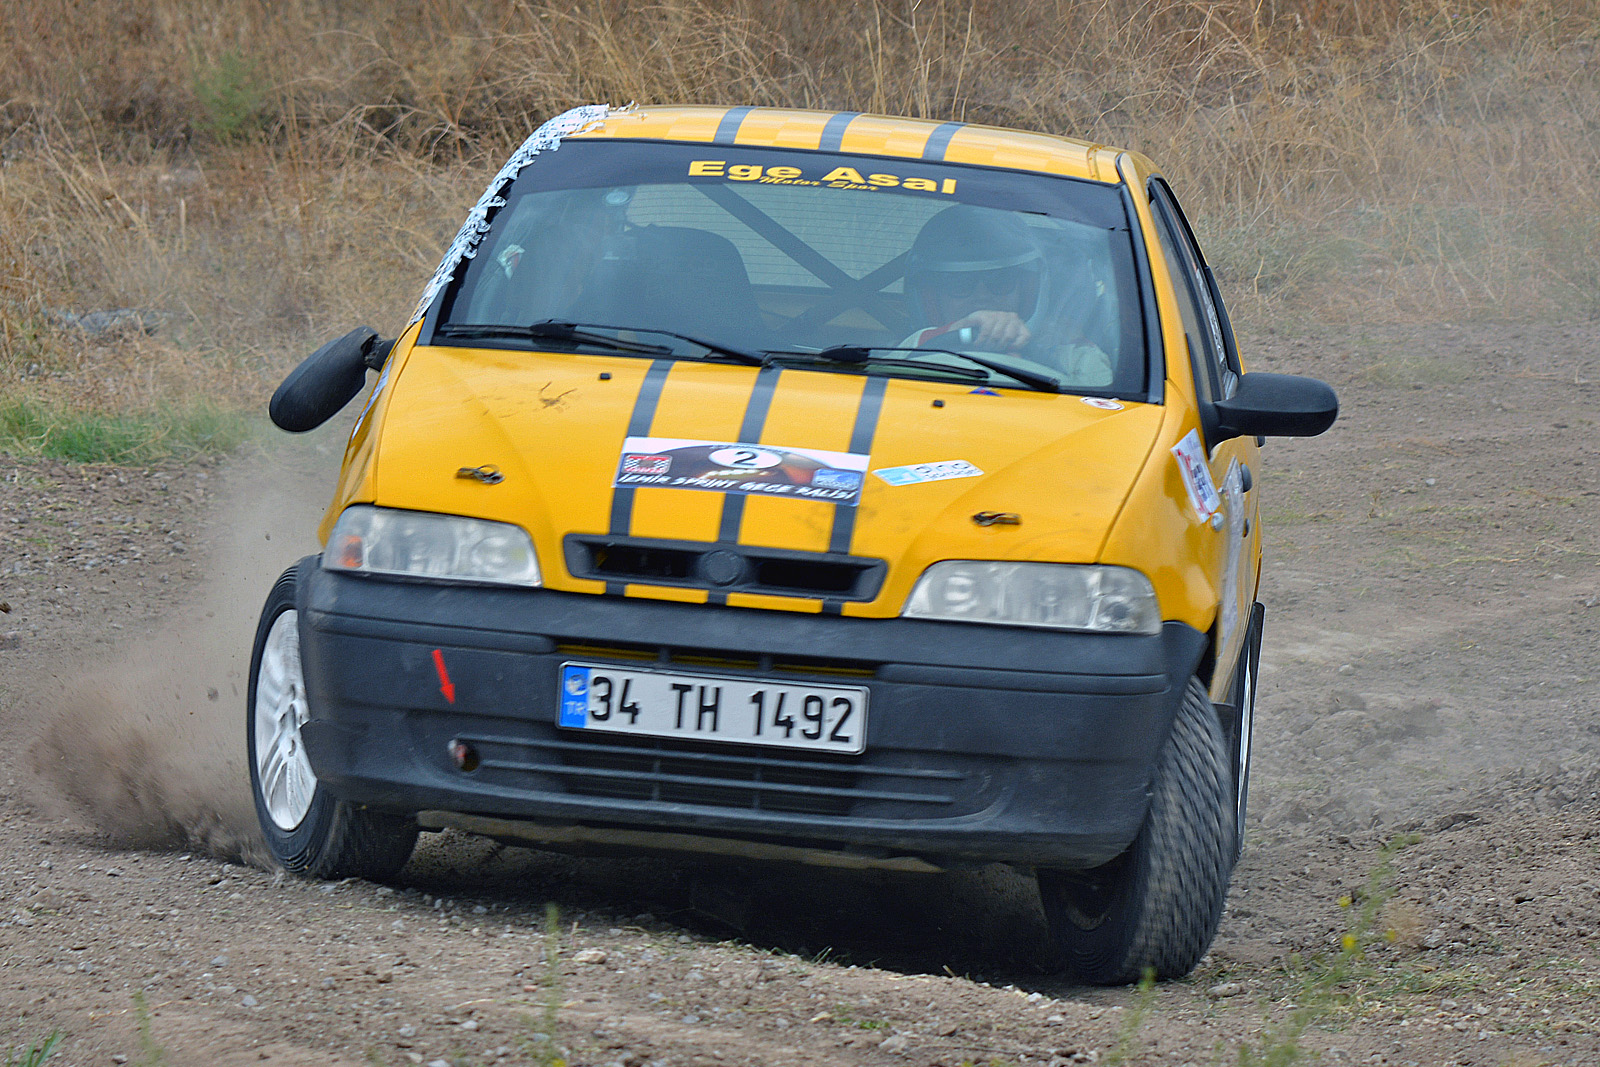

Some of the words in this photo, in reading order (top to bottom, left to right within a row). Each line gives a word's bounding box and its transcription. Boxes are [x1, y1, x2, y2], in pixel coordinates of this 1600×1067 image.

[688, 160, 803, 181] Ege
[821, 166, 957, 194] Asal
[759, 176, 821, 187] Motor
[733, 450, 758, 466] 2
[564, 701, 586, 716] TR
[590, 676, 641, 724] 34
[671, 683, 722, 732] TH
[750, 690, 852, 744] 1492
